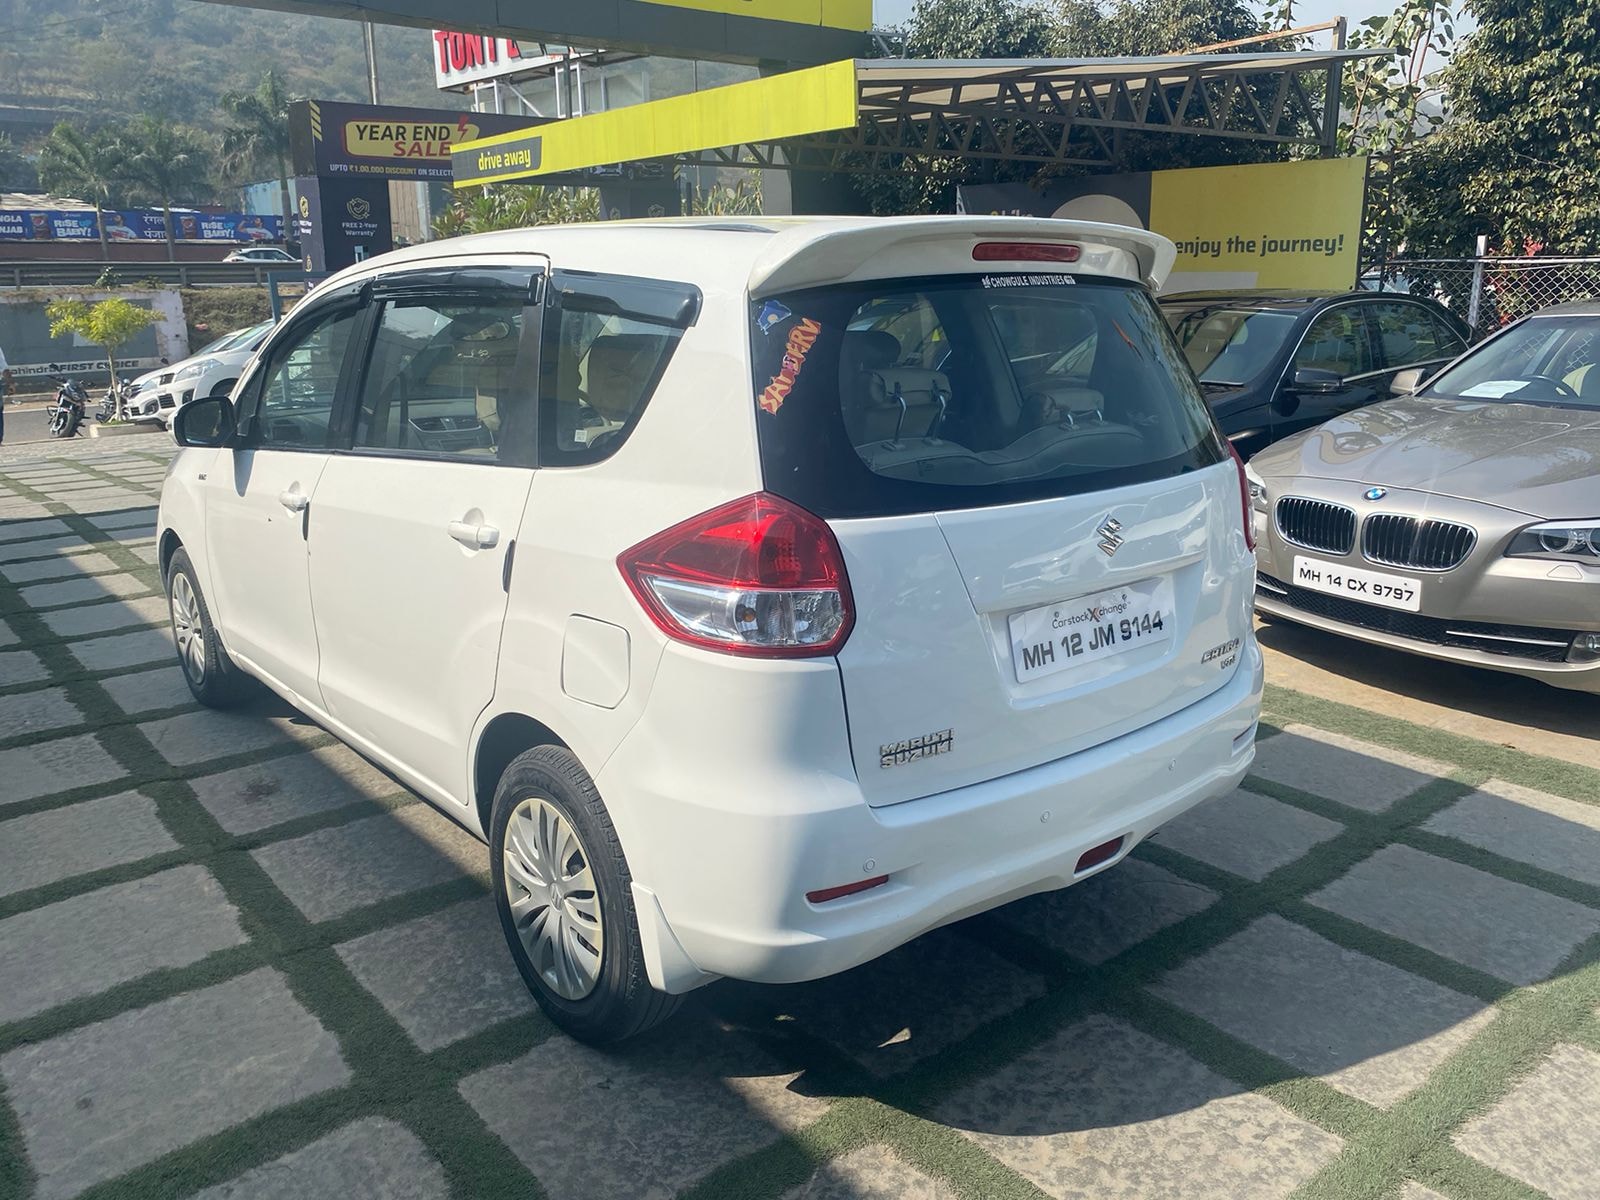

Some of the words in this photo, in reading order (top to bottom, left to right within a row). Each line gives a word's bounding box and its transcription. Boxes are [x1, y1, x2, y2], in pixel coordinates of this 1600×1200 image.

[355, 124, 407, 141] YEAR
[412, 126, 452, 141] END
[392, 141, 453, 157] SALE
[478, 153, 502, 171] drive
[504, 149, 532, 168] away
[329, 164, 348, 172] UPTO
[385, 167, 417, 175] DISCOUNT
[418, 168, 427, 176] ON
[1177, 236, 1221, 258] enjoy
[1227, 235, 1256, 253] the
[1260, 234, 1344, 257] journey!
[990, 276, 1029, 288] CHOWGULE
[1027, 275, 1065, 286] INDUSTRIES
[60, 362, 94, 373] FIRST
[1299, 567, 1321, 582] MH
[1326, 574, 1342, 587] 14
[1346, 578, 1367, 593] CX
[1373, 584, 1414, 602] 9797
[1022, 640, 1055, 670] MH
[1061, 632, 1084, 658] 12
[1088, 623, 1116, 651] JM
[1119, 610, 1164, 641] 9144
[880, 727, 954, 757] MARUTI
[880, 738, 953, 769] SUZUKI
